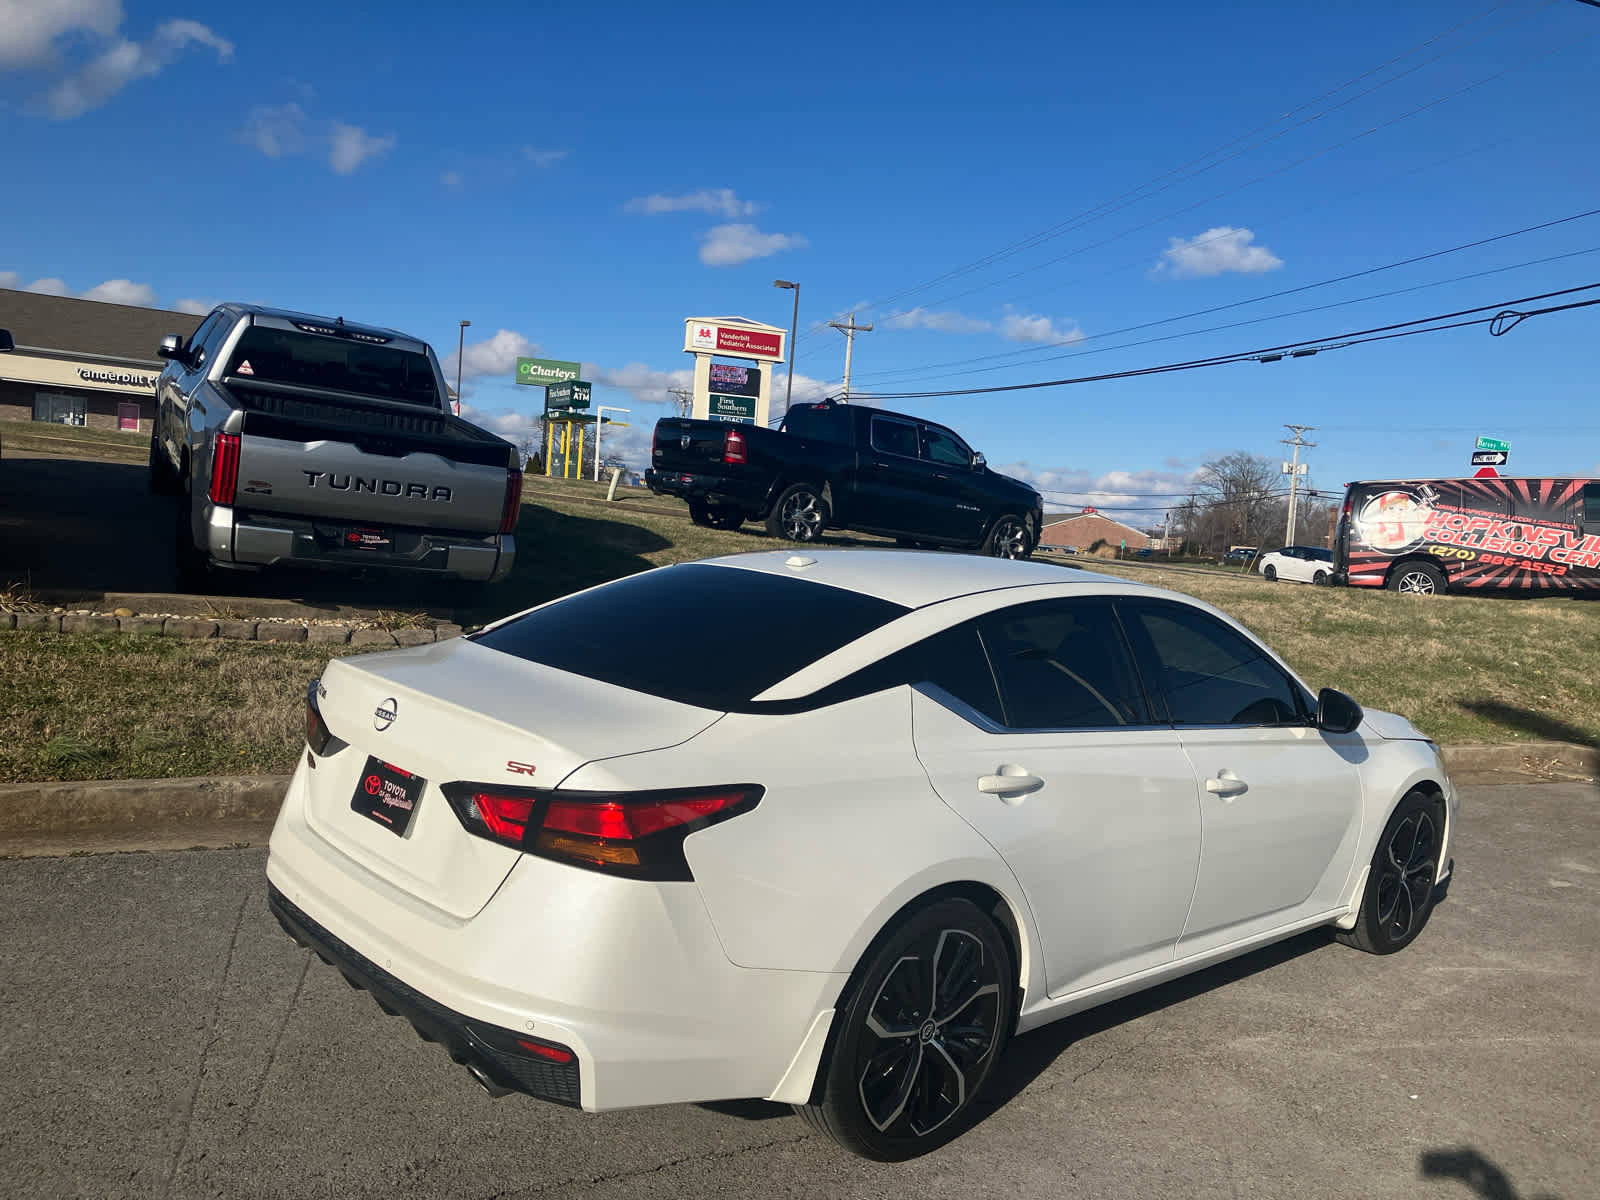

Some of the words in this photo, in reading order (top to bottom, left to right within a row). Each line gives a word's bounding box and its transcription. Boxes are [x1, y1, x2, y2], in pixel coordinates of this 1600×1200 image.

[720, 332, 750, 342] Vanderbilt
[720, 339, 744, 349] Pediatric
[746, 342, 777, 352] Associates
[75, 367, 144, 385] Vanderbilt
[573, 392, 590, 401] ATM
[719, 396, 735, 406] First
[717, 402, 747, 412] Southern
[720, 416, 744, 424] LEGACY
[303, 470, 453, 503] TUNDRA
[1424, 527, 1548, 560] COLLISION
[1549, 547, 1600, 570] CEN
[1429, 545, 1476, 561] (270)
[506, 760, 536, 777] SR
[384, 780, 407, 800] TOYOTA
